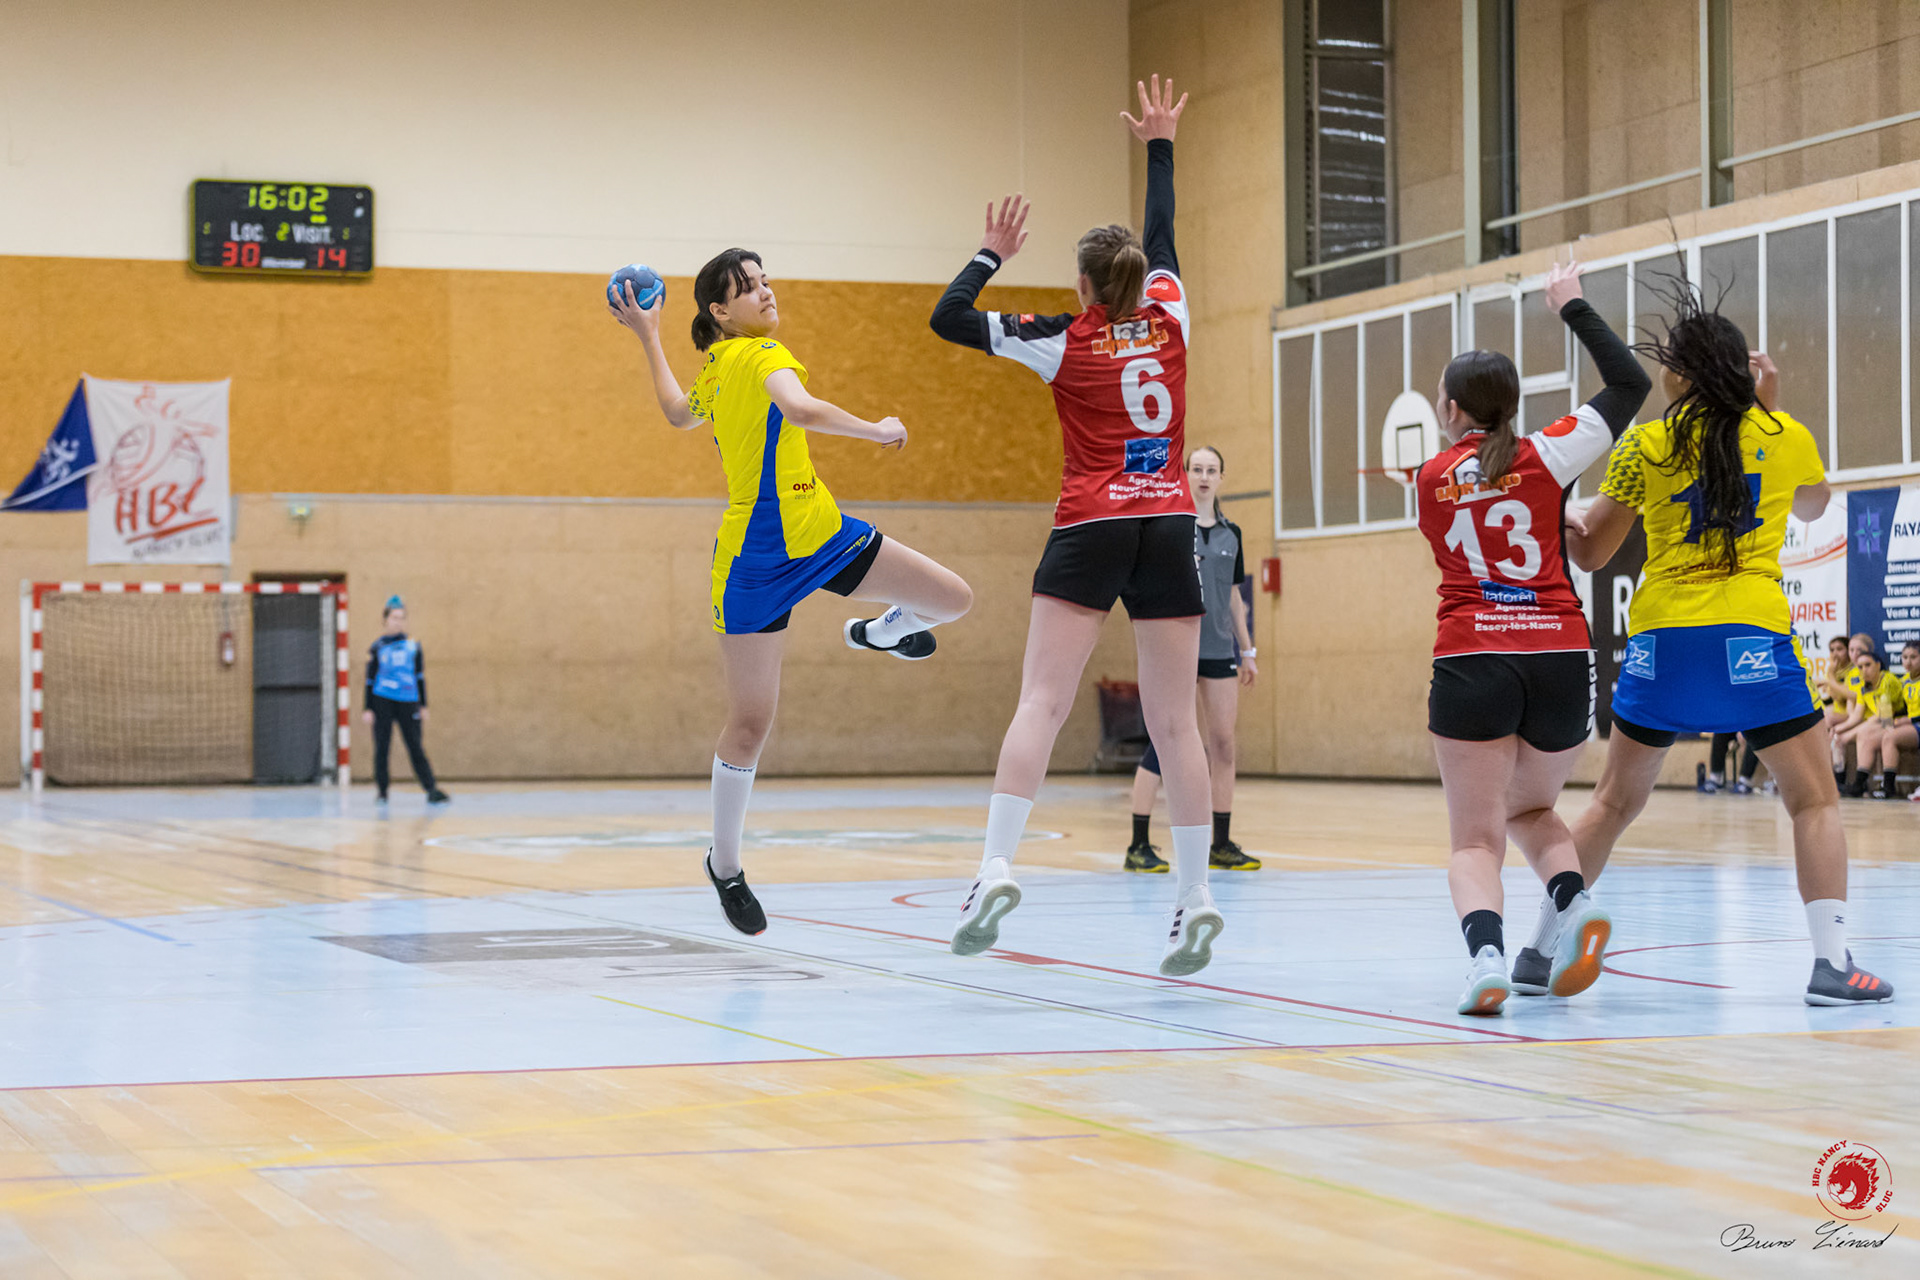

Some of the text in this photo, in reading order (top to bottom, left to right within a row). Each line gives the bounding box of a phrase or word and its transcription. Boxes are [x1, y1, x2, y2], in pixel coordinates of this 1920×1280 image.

[248, 185, 329, 212] 16:02
[276, 222, 290, 241] 2
[222, 241, 260, 267] 30
[317, 248, 347, 268] 14
[1121, 358, 1172, 433] 6
[1444, 500, 1542, 580] 13
[1475, 613, 1559, 621] Neuves-Maisons
[1495, 604, 1541, 612] Agences
[1475, 622, 1563, 632] Essey-lès-Nancy
[1735, 651, 1771, 669] AZ
[1733, 671, 1775, 681] MEDICAL
